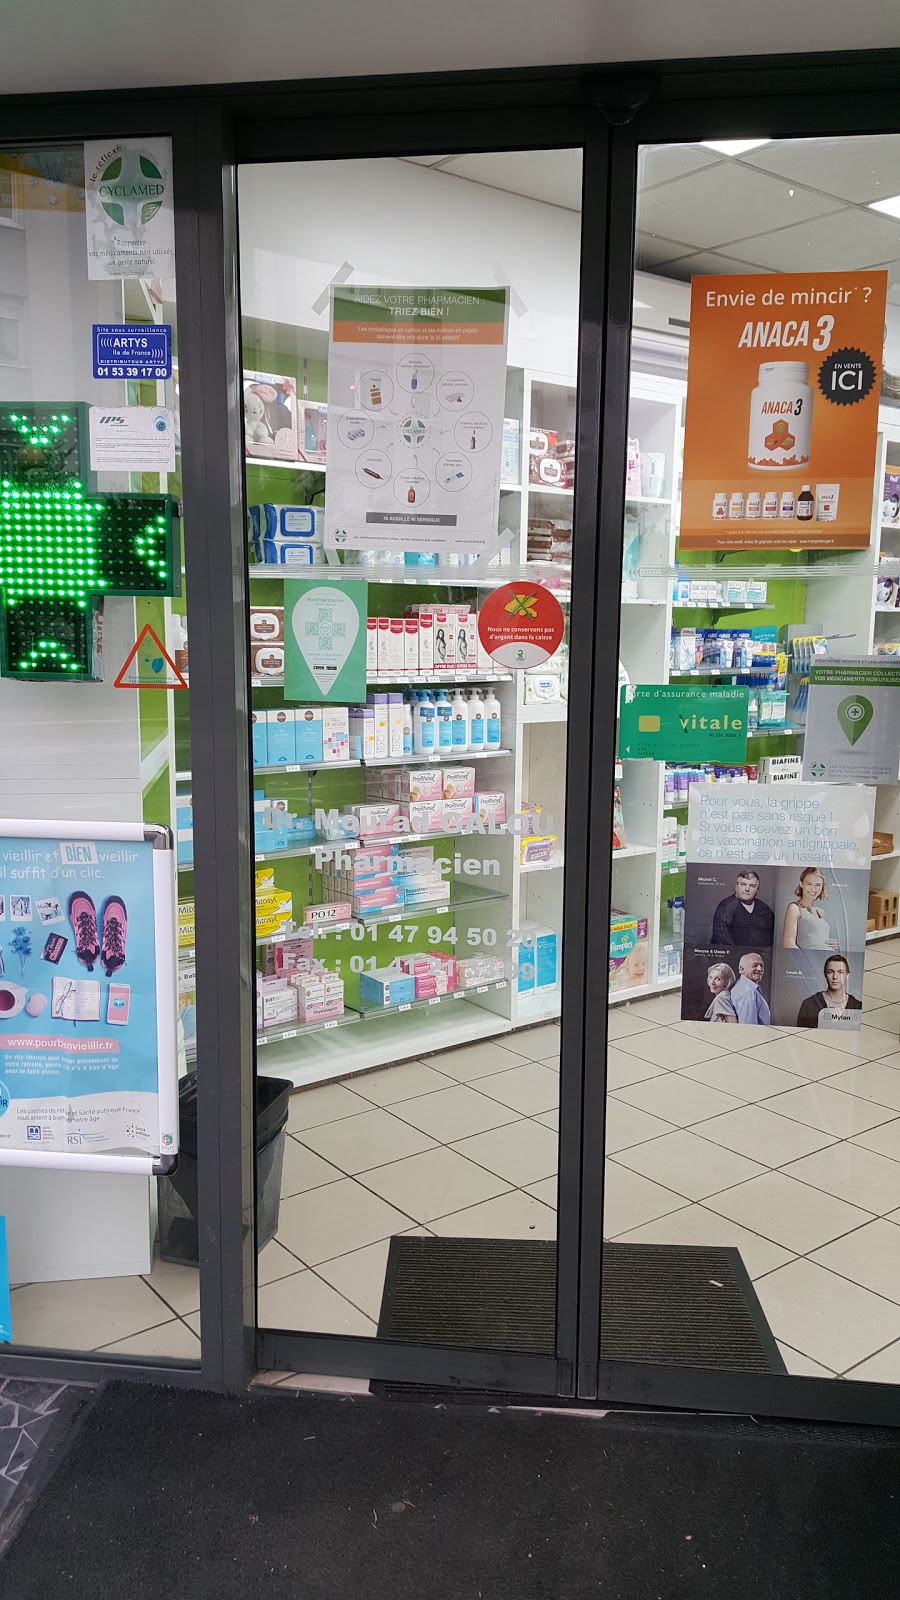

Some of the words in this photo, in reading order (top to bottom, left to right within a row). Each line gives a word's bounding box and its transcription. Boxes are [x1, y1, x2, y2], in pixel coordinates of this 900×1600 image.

[99, 184, 165, 197] CYCLAMED
[354, 294, 381, 304] AIDEZ
[383, 295, 415, 305] VOTRE
[417, 296, 480, 305] PHARMACIEN
[705, 290, 756, 307] Envie
[761, 288, 785, 306] de
[862, 286, 873, 303] ?
[388, 307, 418, 316] TRIEZ
[420, 307, 444, 316] BIEN
[738, 320, 810, 348] ANACA
[812, 314, 835, 352] 3
[113, 337, 148, 348] ARTYS
[97, 367, 109, 376] 01
[111, 367, 124, 376] 53
[126, 367, 138, 376] 39
[141, 367, 153, 376] 17
[155, 368, 167, 377] 00
[831, 370, 863, 391] ICI
[761, 401, 793, 415] ANACA
[794, 398, 803, 416] 3
[489, 634, 514, 642] d'argent
[653, 689, 707, 698] d'assurance
[709, 689, 745, 698] maladie
[771, 757, 799, 765] BIAFINE
[773, 772, 798, 781] BIAFINE
[699, 794, 728, 807] Pour
[732, 798, 764, 809] vous,
[767, 797, 778, 808] la
[780, 798, 820, 811] grippe
[264, 806, 303, 830] Dr.
[315, 808, 429, 833] Mourad
[699, 808, 729, 820] n'est
[732, 811, 754, 822] pas
[757, 812, 786, 821] sans
[789, 812, 826, 824] risque
[699, 821, 711, 832] Si
[714, 824, 742, 833] vous
[745, 825, 792, 835] recevez
[795, 826, 810, 835] un
[813, 825, 838, 837] bon
[698, 834, 714, 845] de
[717, 836, 784, 848] vaccination
[787, 838, 859, 851] antigrippale,
[2, 849, 42, 862] vieillir
[45, 850, 60, 862] et
[99, 850, 139, 863] vieillir
[698, 849, 713, 858] ce
[715, 847, 749, 859] n'est
[748, 850, 770, 862] pas
[773, 852, 789, 860] un
[315, 849, 500, 876] Pharmacien
[10, 866, 46, 879] suffit
[50, 866, 77, 879] d'un
[80, 866, 105, 879] clic.
[350, 925, 379, 942] 01
[389, 926, 419, 943] 47
[427, 926, 459, 945] 94
[466, 928, 497, 946] 50
[506, 929, 538, 948] 20
[610, 941, 633, 952] Pampers
[284, 953, 327, 972] Fax
[350, 955, 378, 973] 01
[78, 1108, 96, 1116] Santé
[97, 1106, 122, 1116] publique
[67, 1135, 82, 1145] RSI
